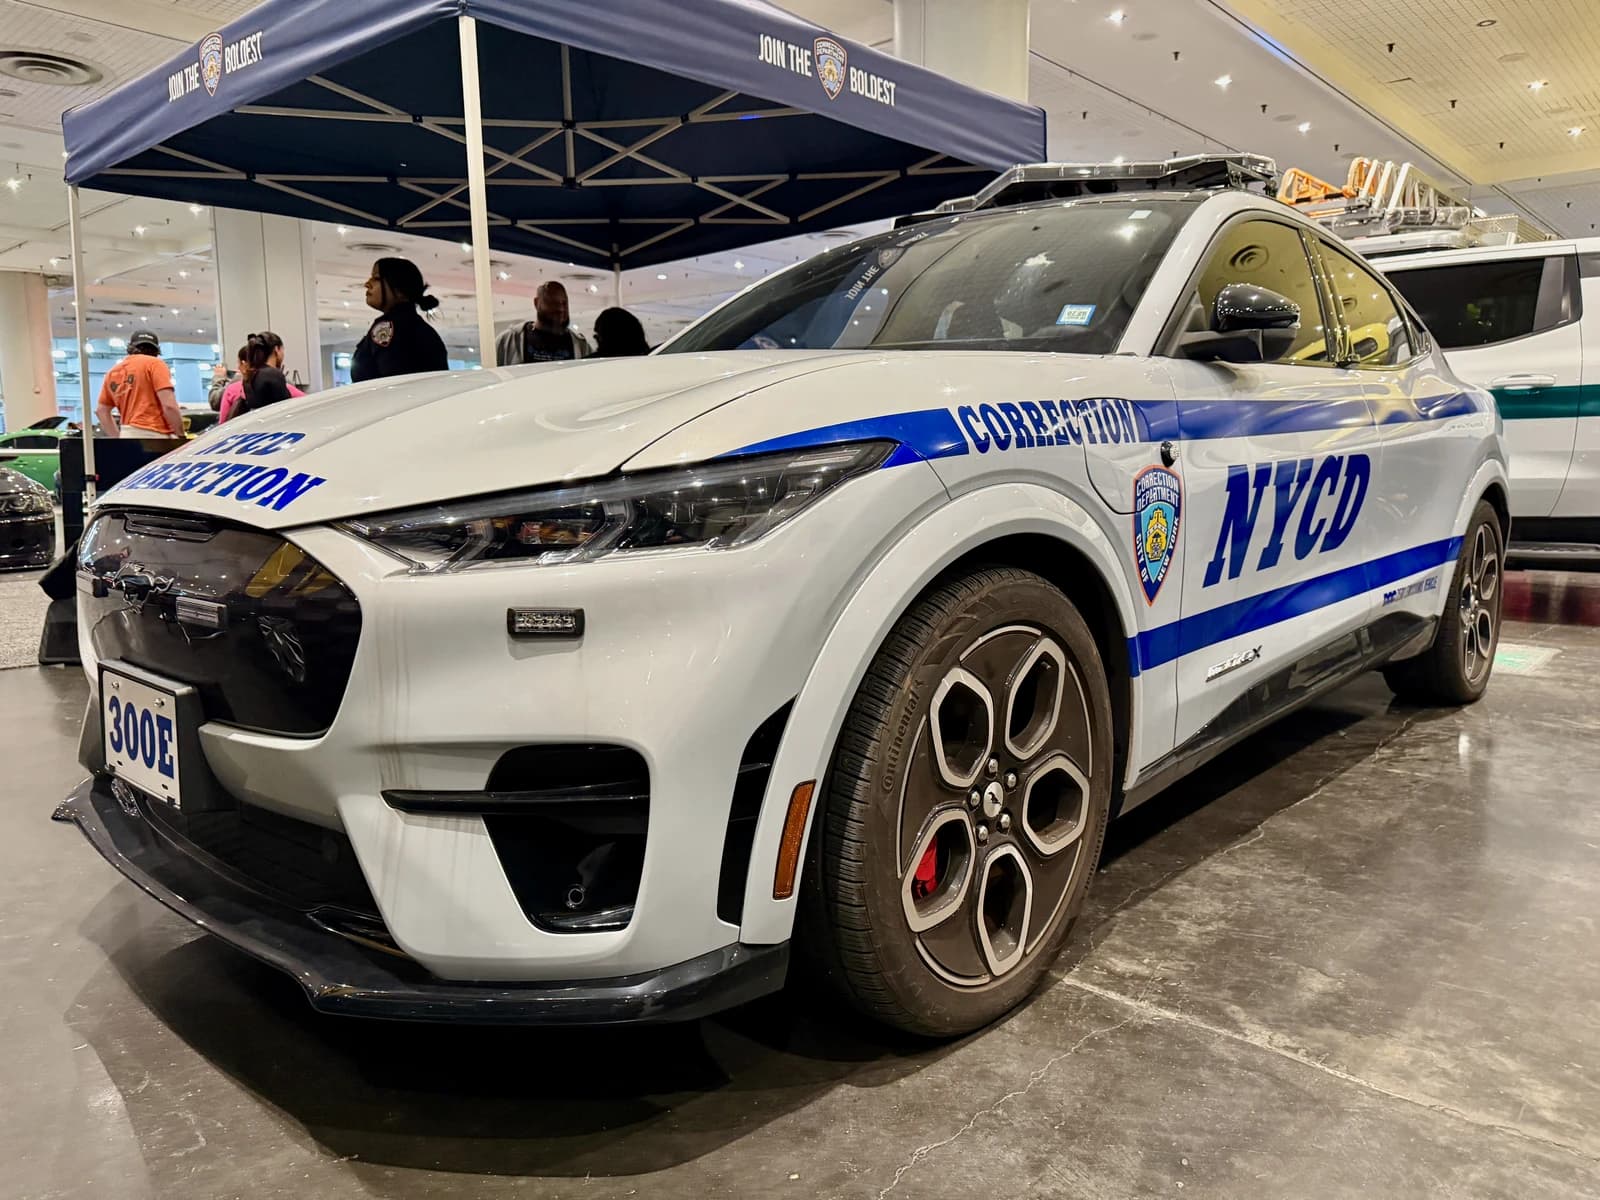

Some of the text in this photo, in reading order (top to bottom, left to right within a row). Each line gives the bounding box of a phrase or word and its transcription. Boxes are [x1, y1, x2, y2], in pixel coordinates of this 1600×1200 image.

[168, 70, 185, 103] JOIN
[184, 62, 200, 93] THE
[224, 31, 263, 75] BOLDEST
[758, 33, 786, 69] JOIN
[787, 43, 813, 78] THE
[850, 66, 896, 107] BOLDEST
[194, 431, 306, 456] NYCD
[957, 399, 1137, 454] CORRECTION
[1136, 471, 1180, 497] CORRECTION
[1136, 486, 1180, 512] DEPARTMENT
[1136, 516, 1179, 582] CITY OF NEW YORK
[1202, 453, 1371, 589] NYCD
[108, 695, 175, 780] 300E
[880, 689, 920, 794] Continental
